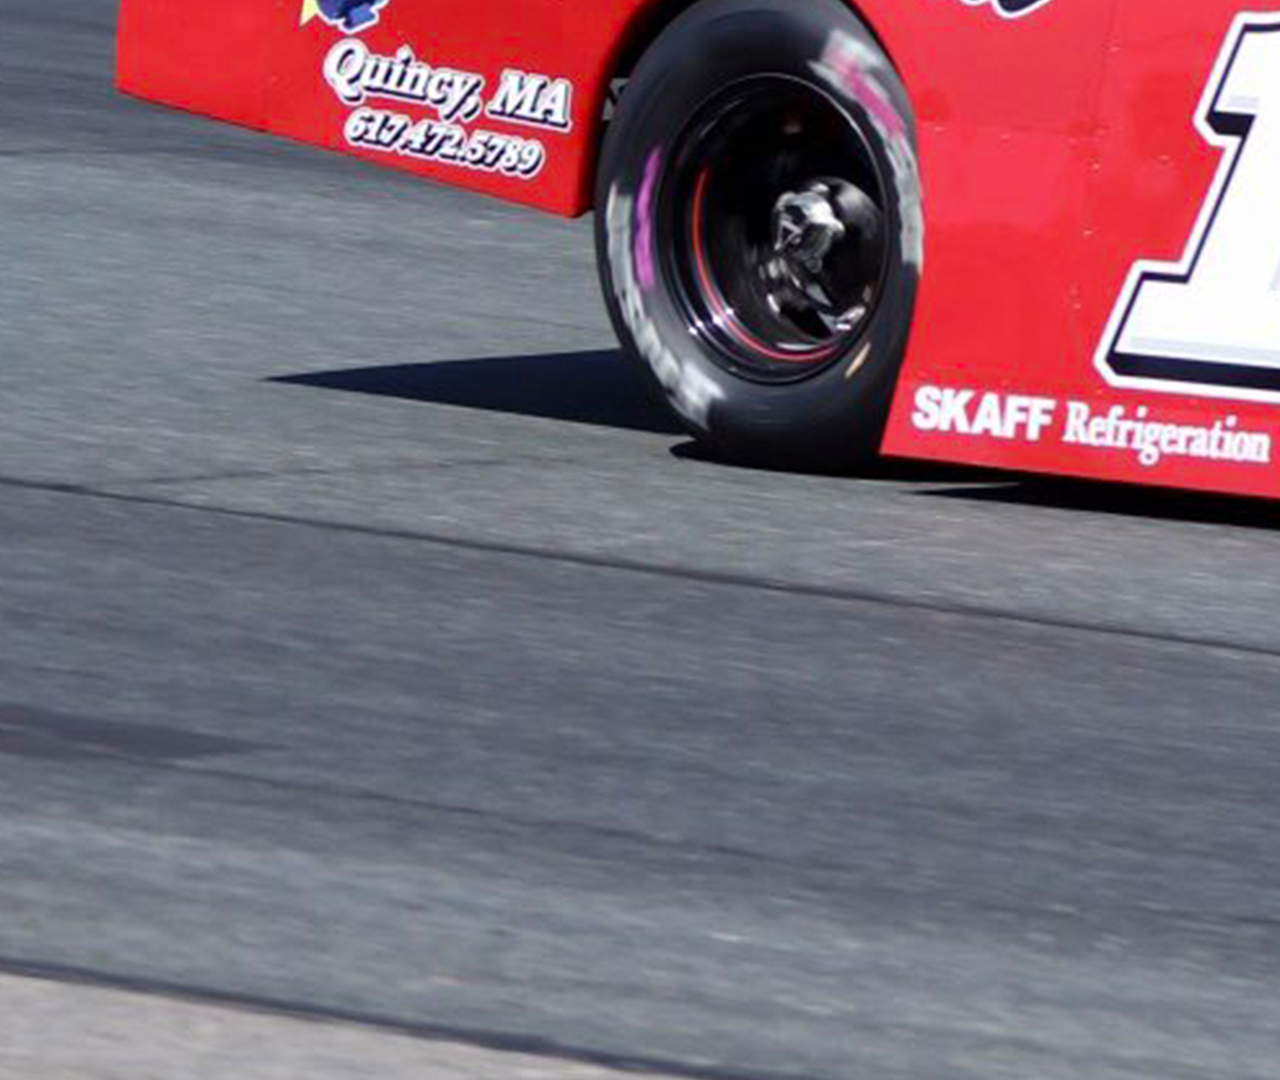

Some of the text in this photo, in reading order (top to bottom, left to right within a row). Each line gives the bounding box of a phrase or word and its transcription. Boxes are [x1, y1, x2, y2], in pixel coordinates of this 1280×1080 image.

[323, 37, 572, 132] Quincy, MA
[911, 384, 1271, 466] SKAFF Refrigeration
